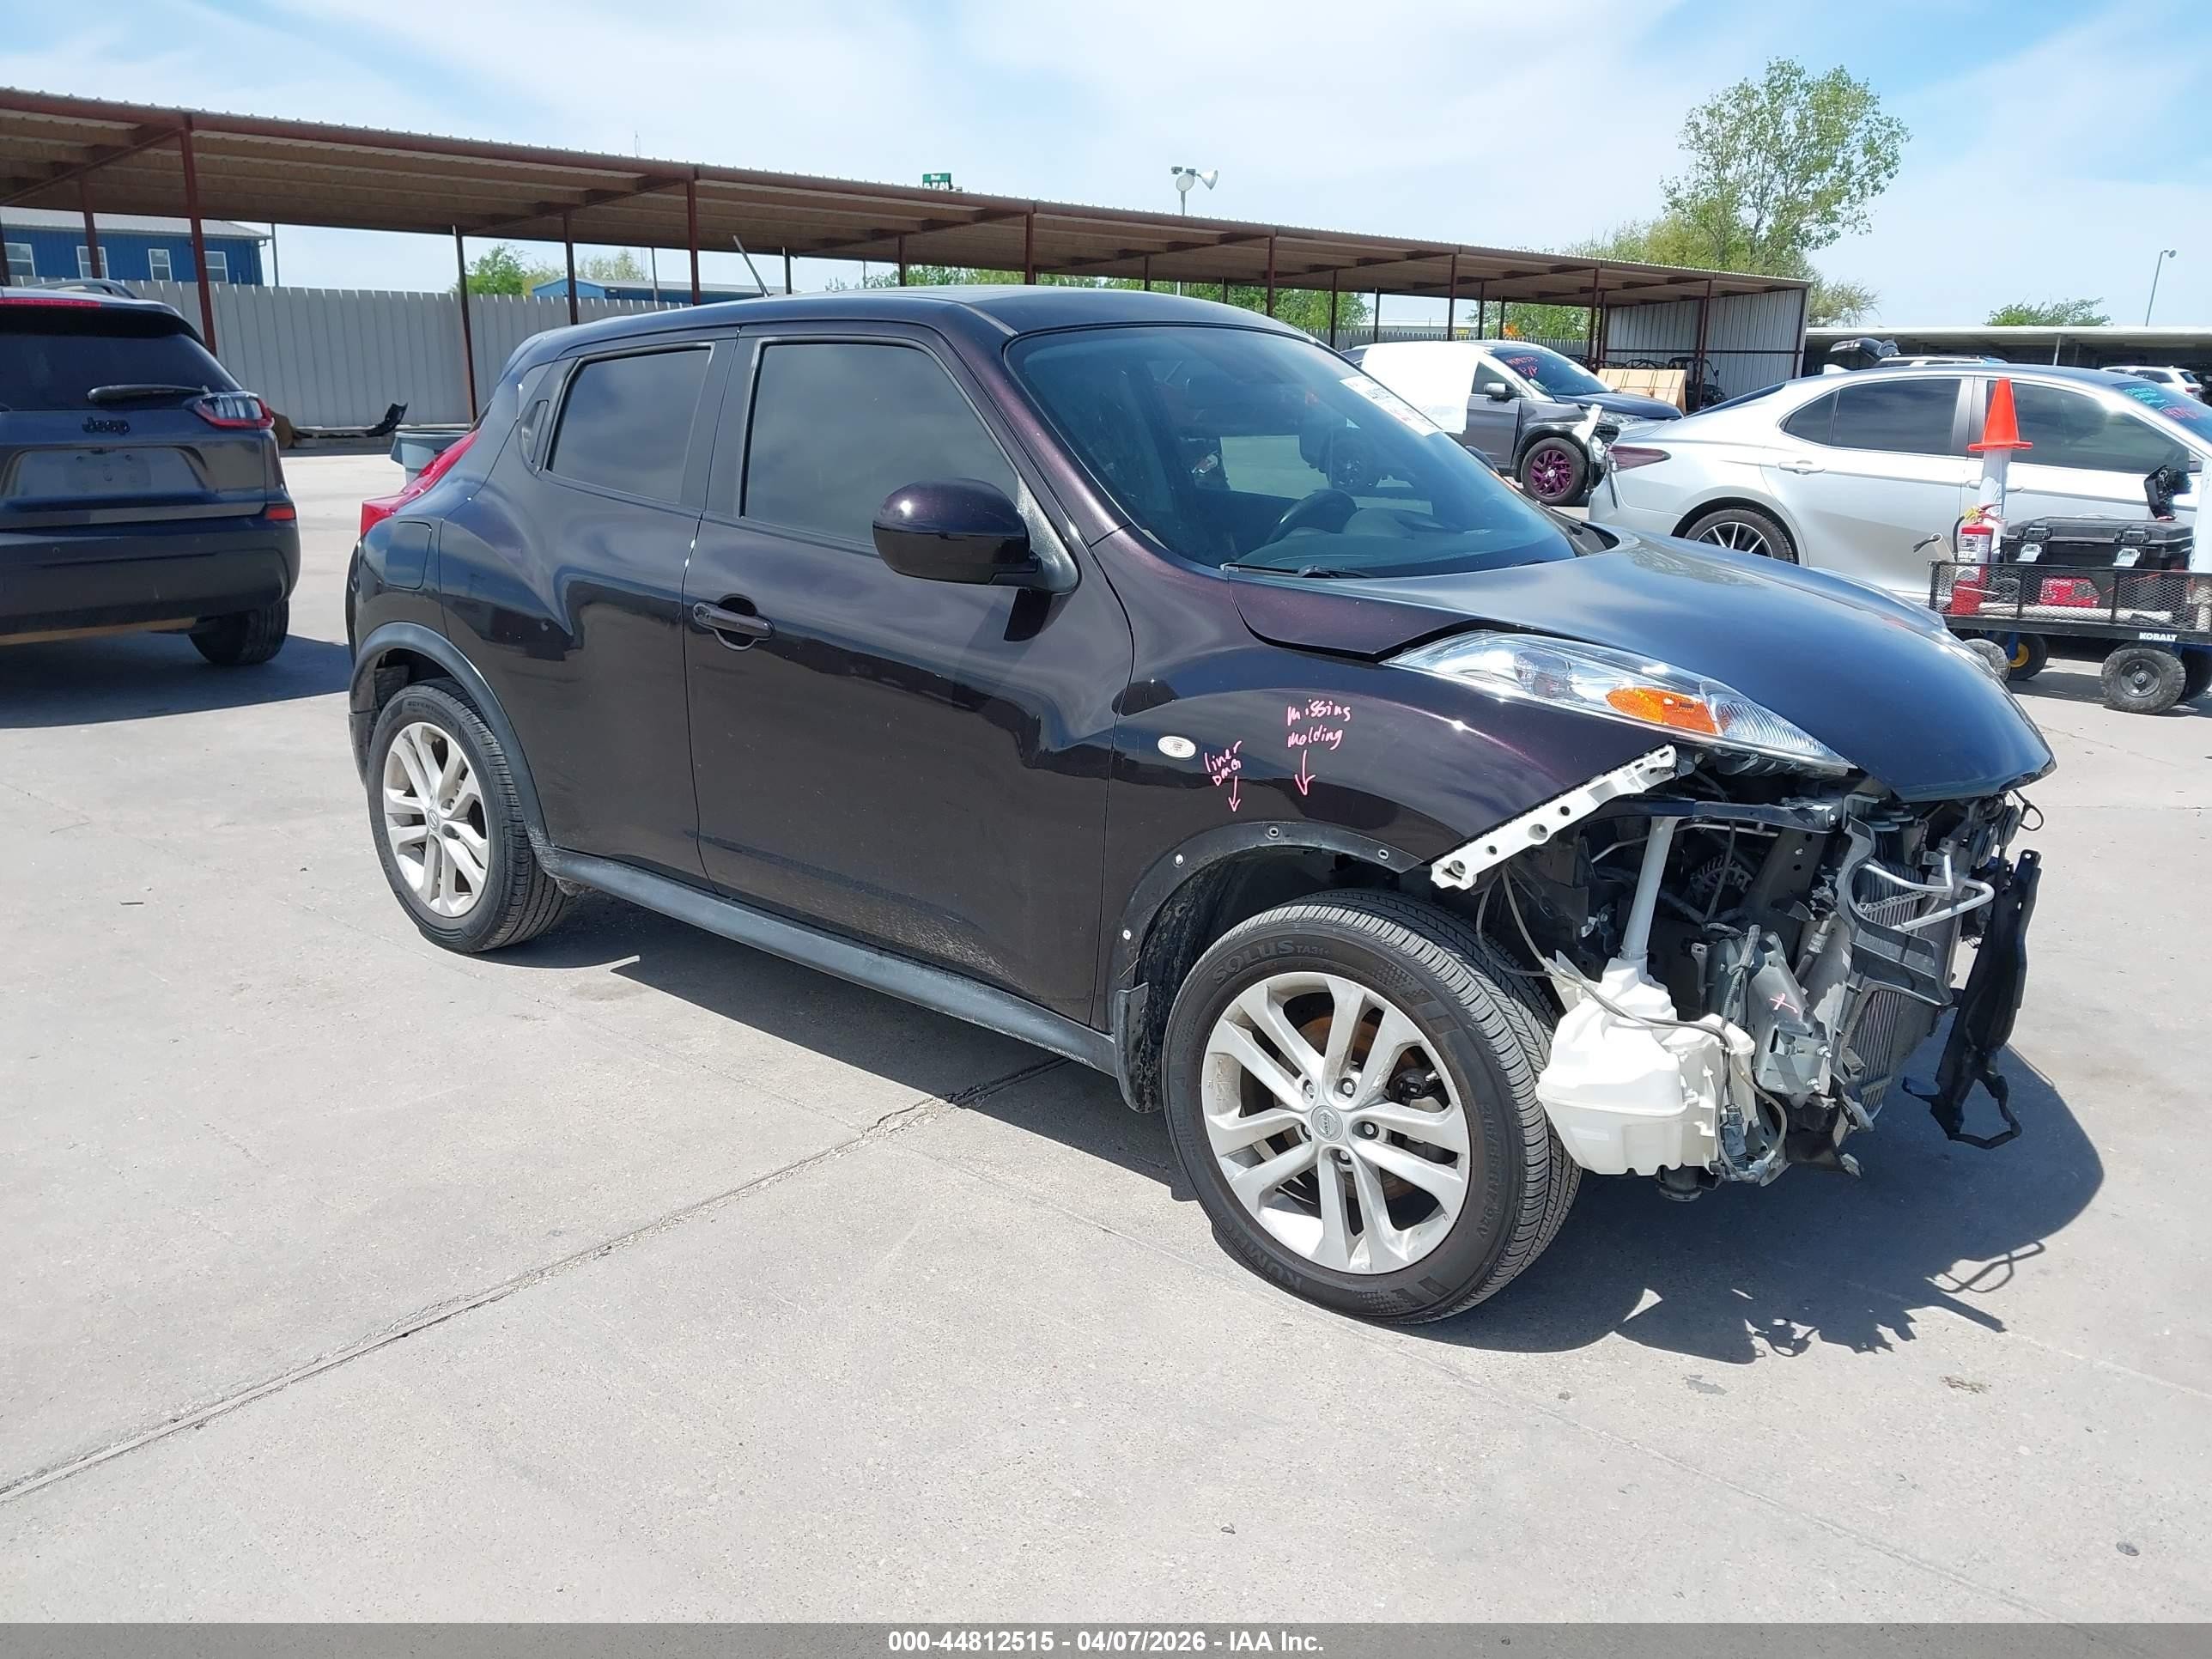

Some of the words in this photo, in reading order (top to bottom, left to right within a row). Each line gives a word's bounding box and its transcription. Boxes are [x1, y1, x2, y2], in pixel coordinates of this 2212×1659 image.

[82, 416, 131, 435] Jeep
[2139, 632, 2178, 642] KOBALT
[1212, 940, 1295, 985] SOLUS
